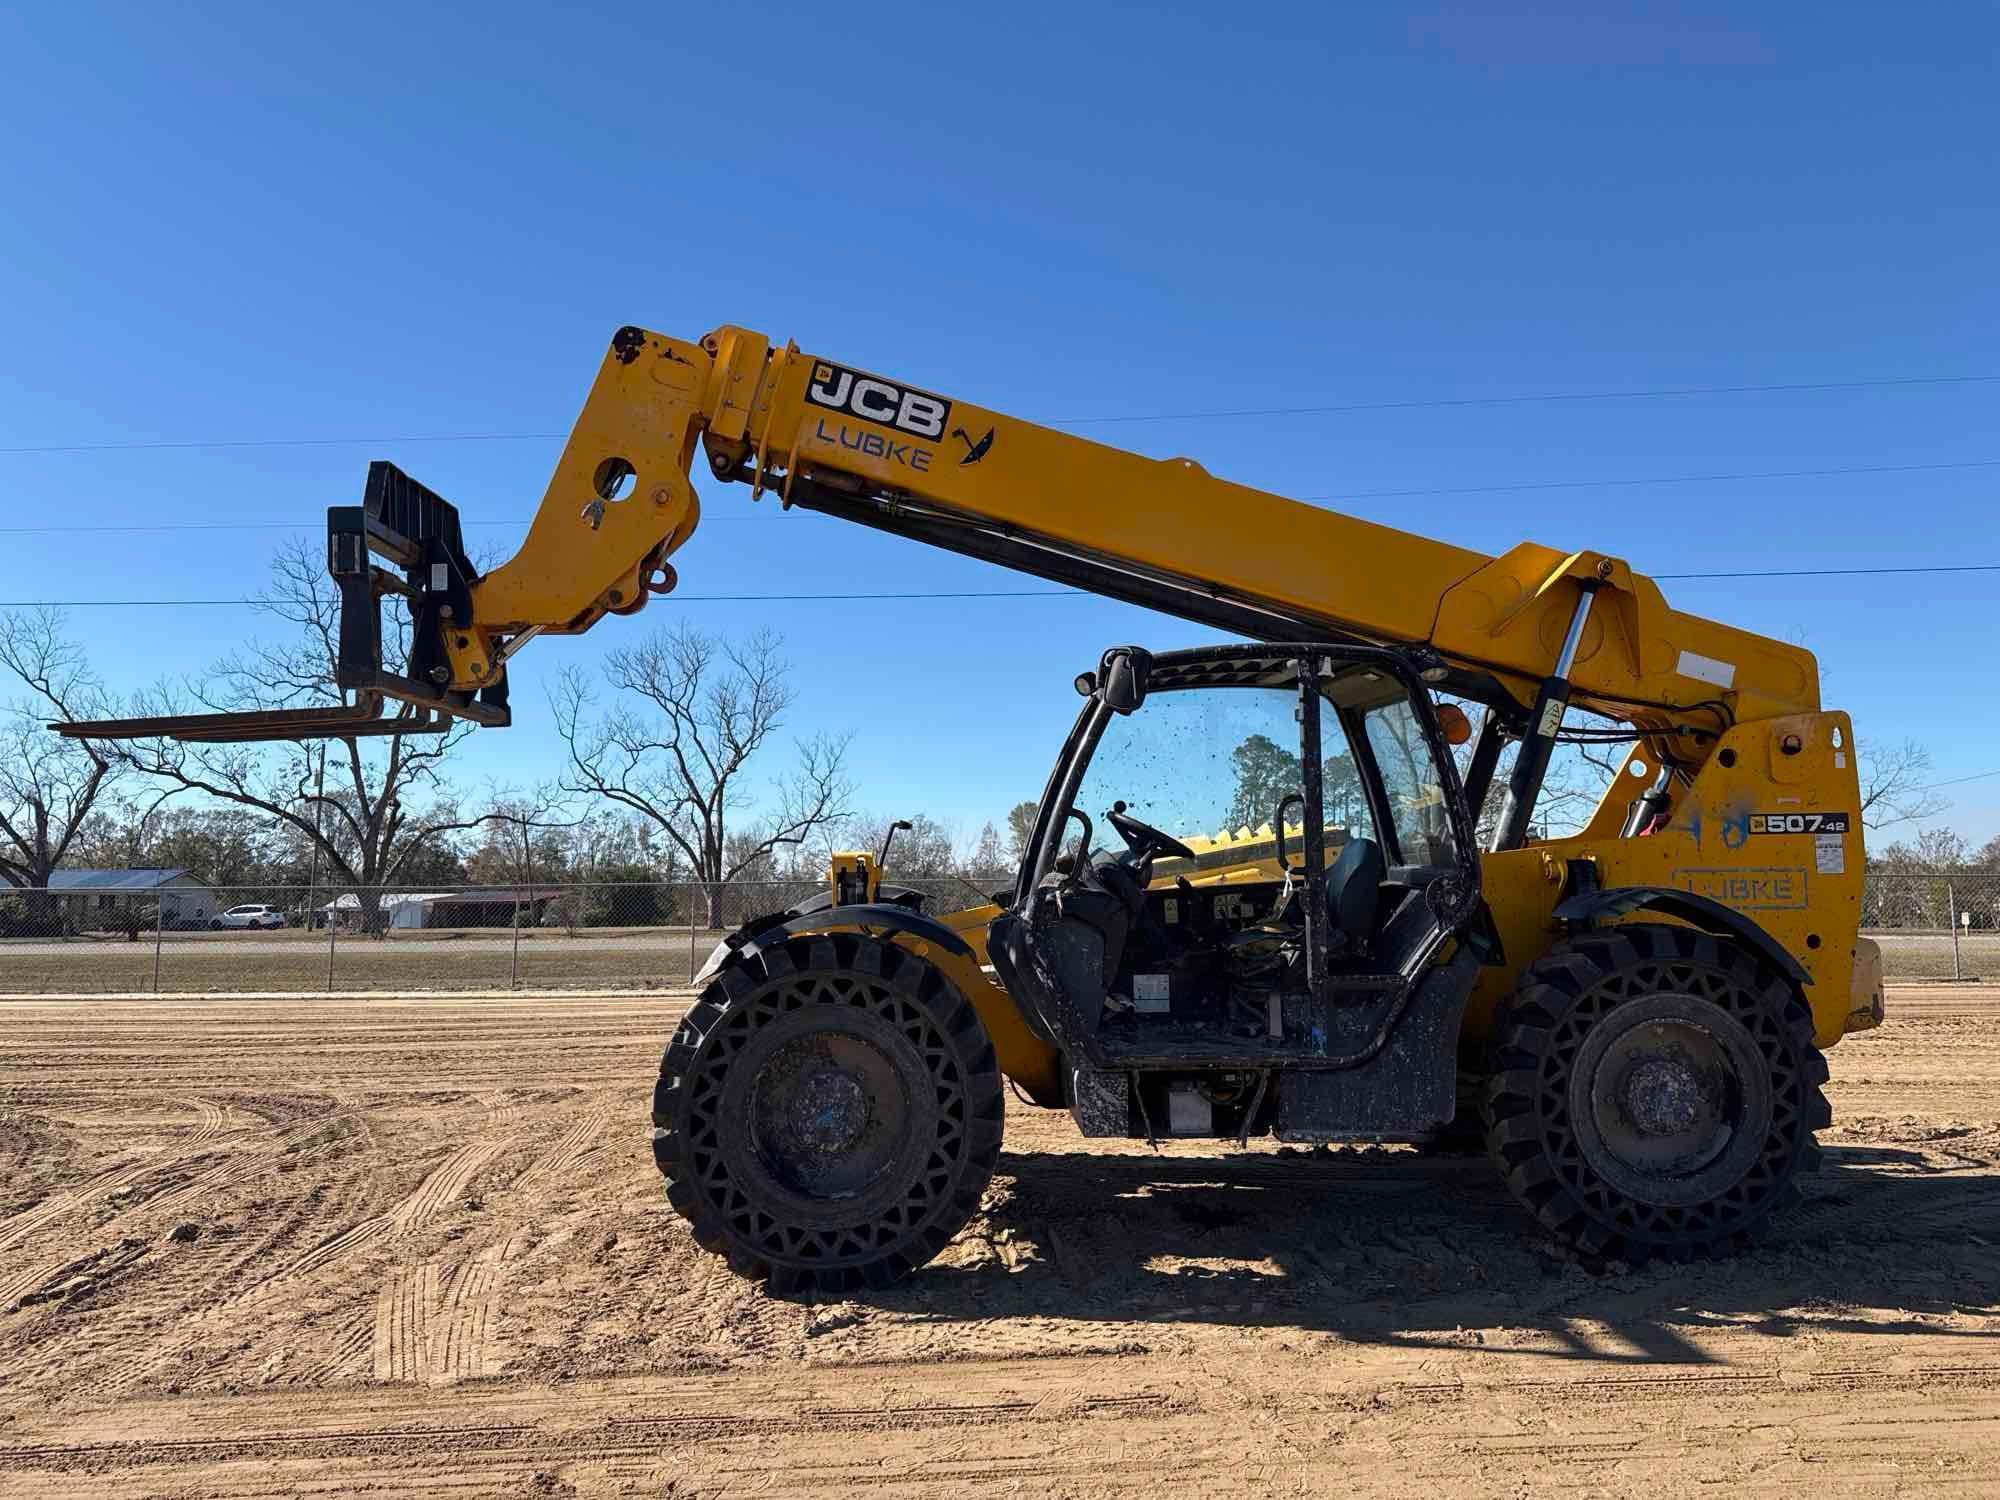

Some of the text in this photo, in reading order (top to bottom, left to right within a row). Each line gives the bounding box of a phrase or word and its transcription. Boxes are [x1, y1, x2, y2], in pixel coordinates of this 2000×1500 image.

[810, 372, 946, 437] JCB
[816, 418, 933, 472] LUBKE
[1767, 815, 1845, 833] 507-42
